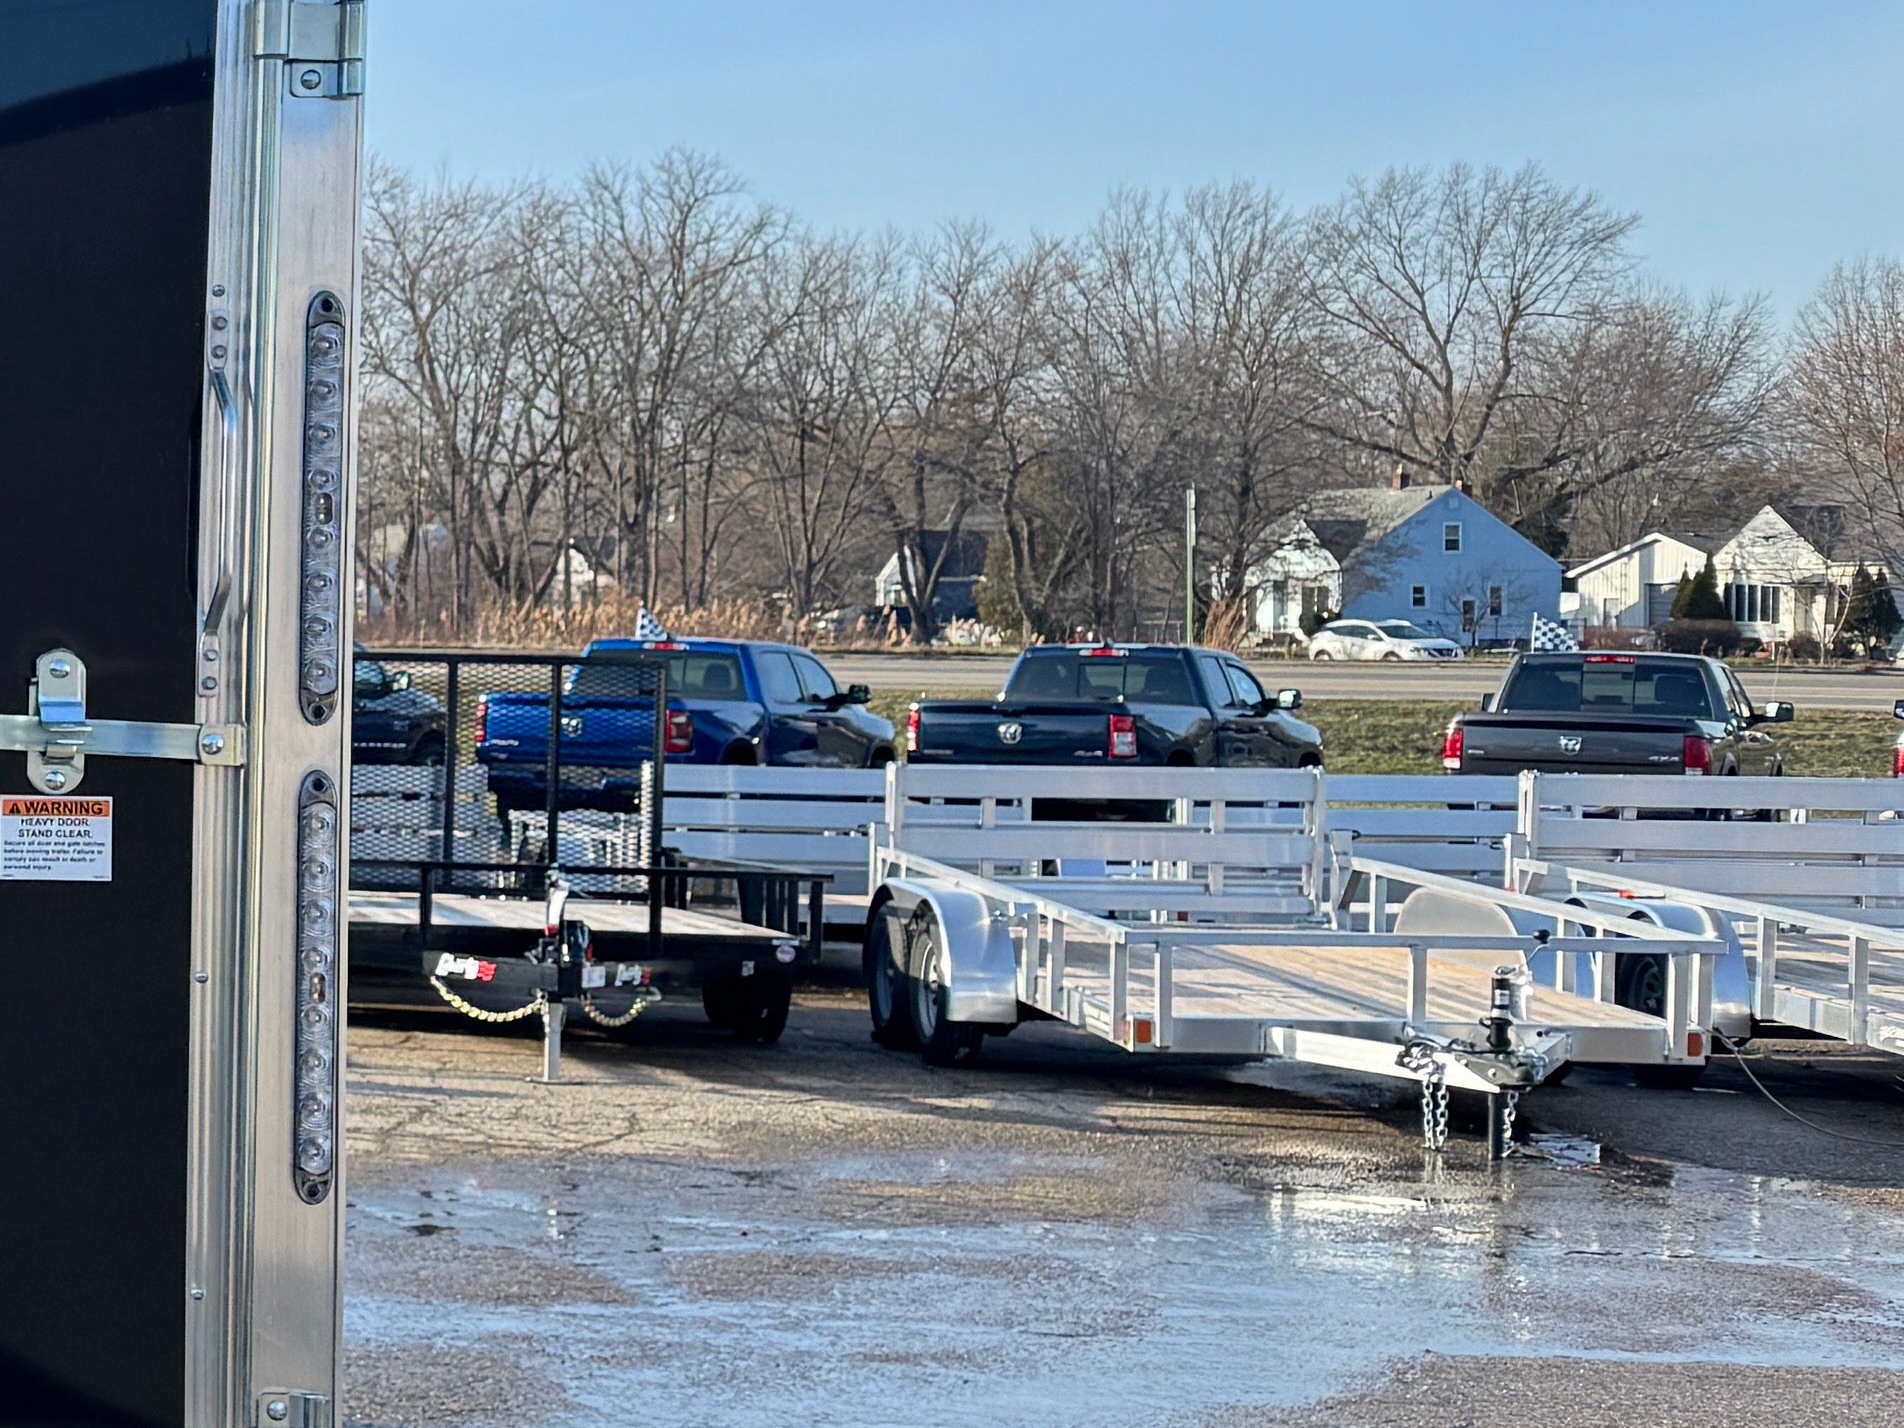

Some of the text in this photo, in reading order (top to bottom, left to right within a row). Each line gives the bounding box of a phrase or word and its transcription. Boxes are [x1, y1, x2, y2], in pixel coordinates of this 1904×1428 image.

[23, 801, 104, 815] WARNING
[21, 818, 54, 826] HEAVY
[18, 829, 53, 838] STAND
